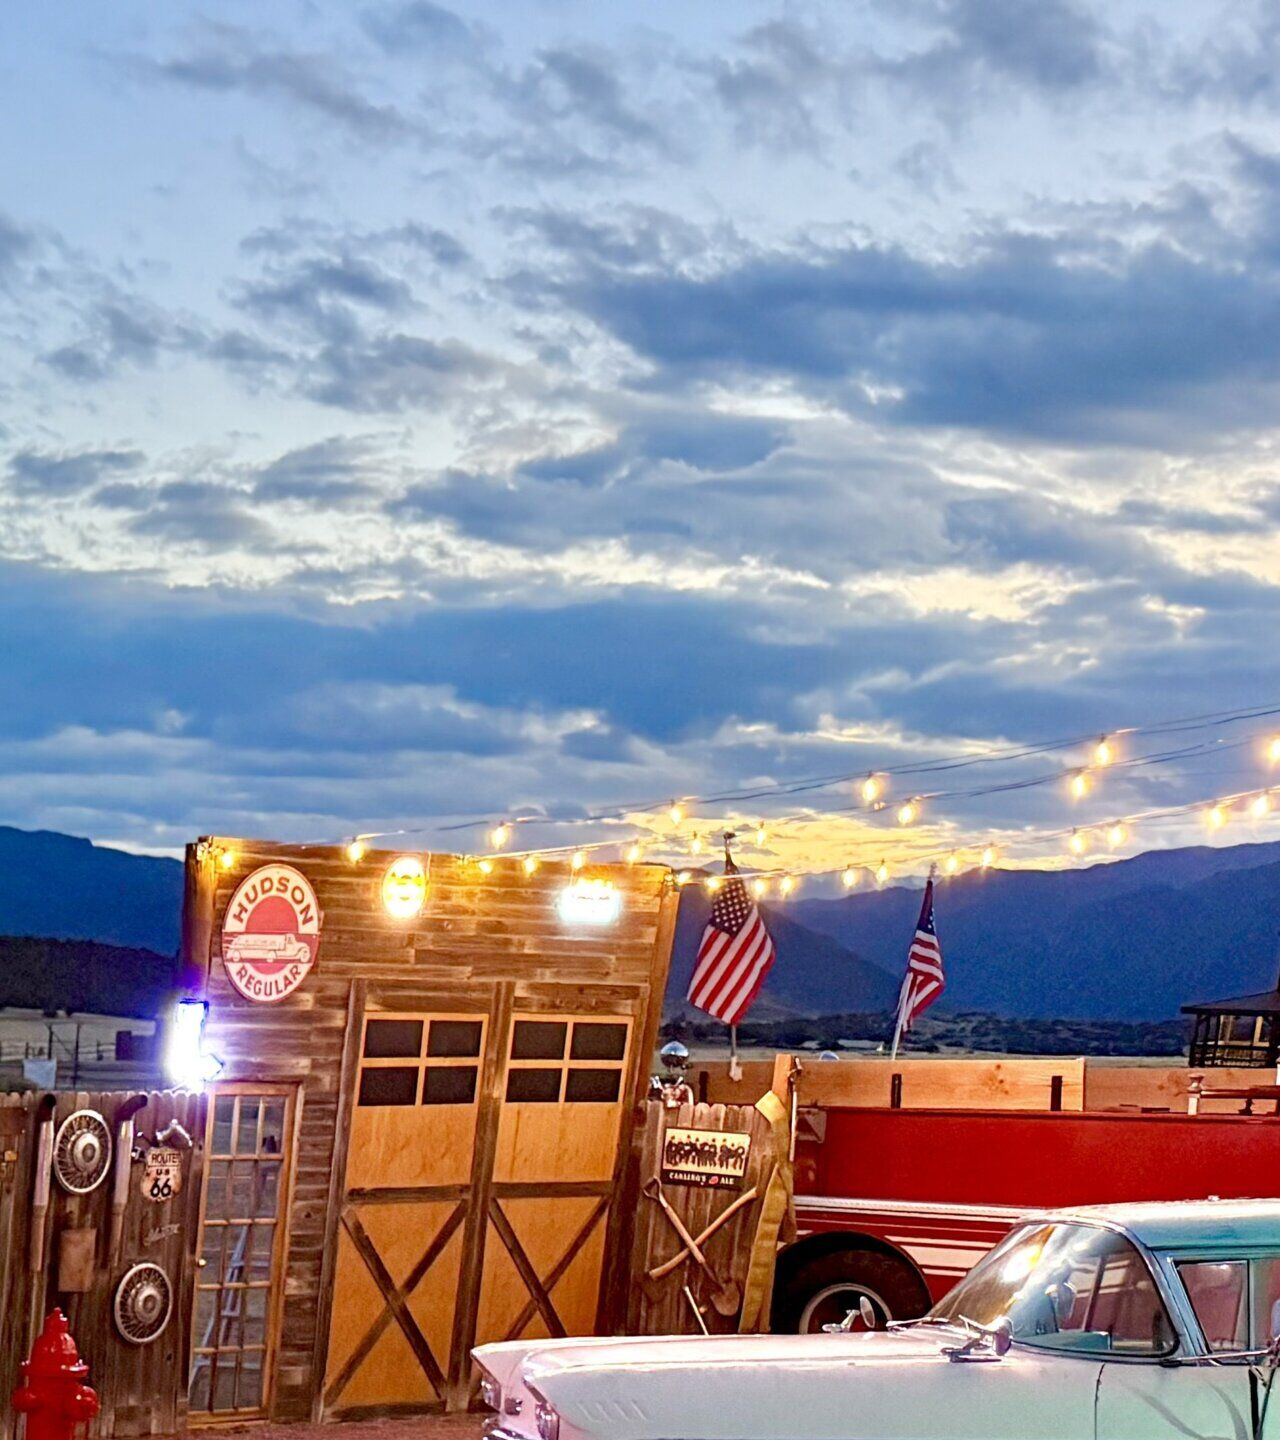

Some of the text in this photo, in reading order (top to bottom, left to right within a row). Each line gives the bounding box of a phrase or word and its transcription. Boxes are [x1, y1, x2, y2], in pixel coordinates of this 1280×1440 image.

[233, 876, 314, 925] HUDSON
[236, 964, 301, 996] REGULAR
[151, 1153, 178, 1164] ROUTE
[150, 1178, 172, 1197] 66
